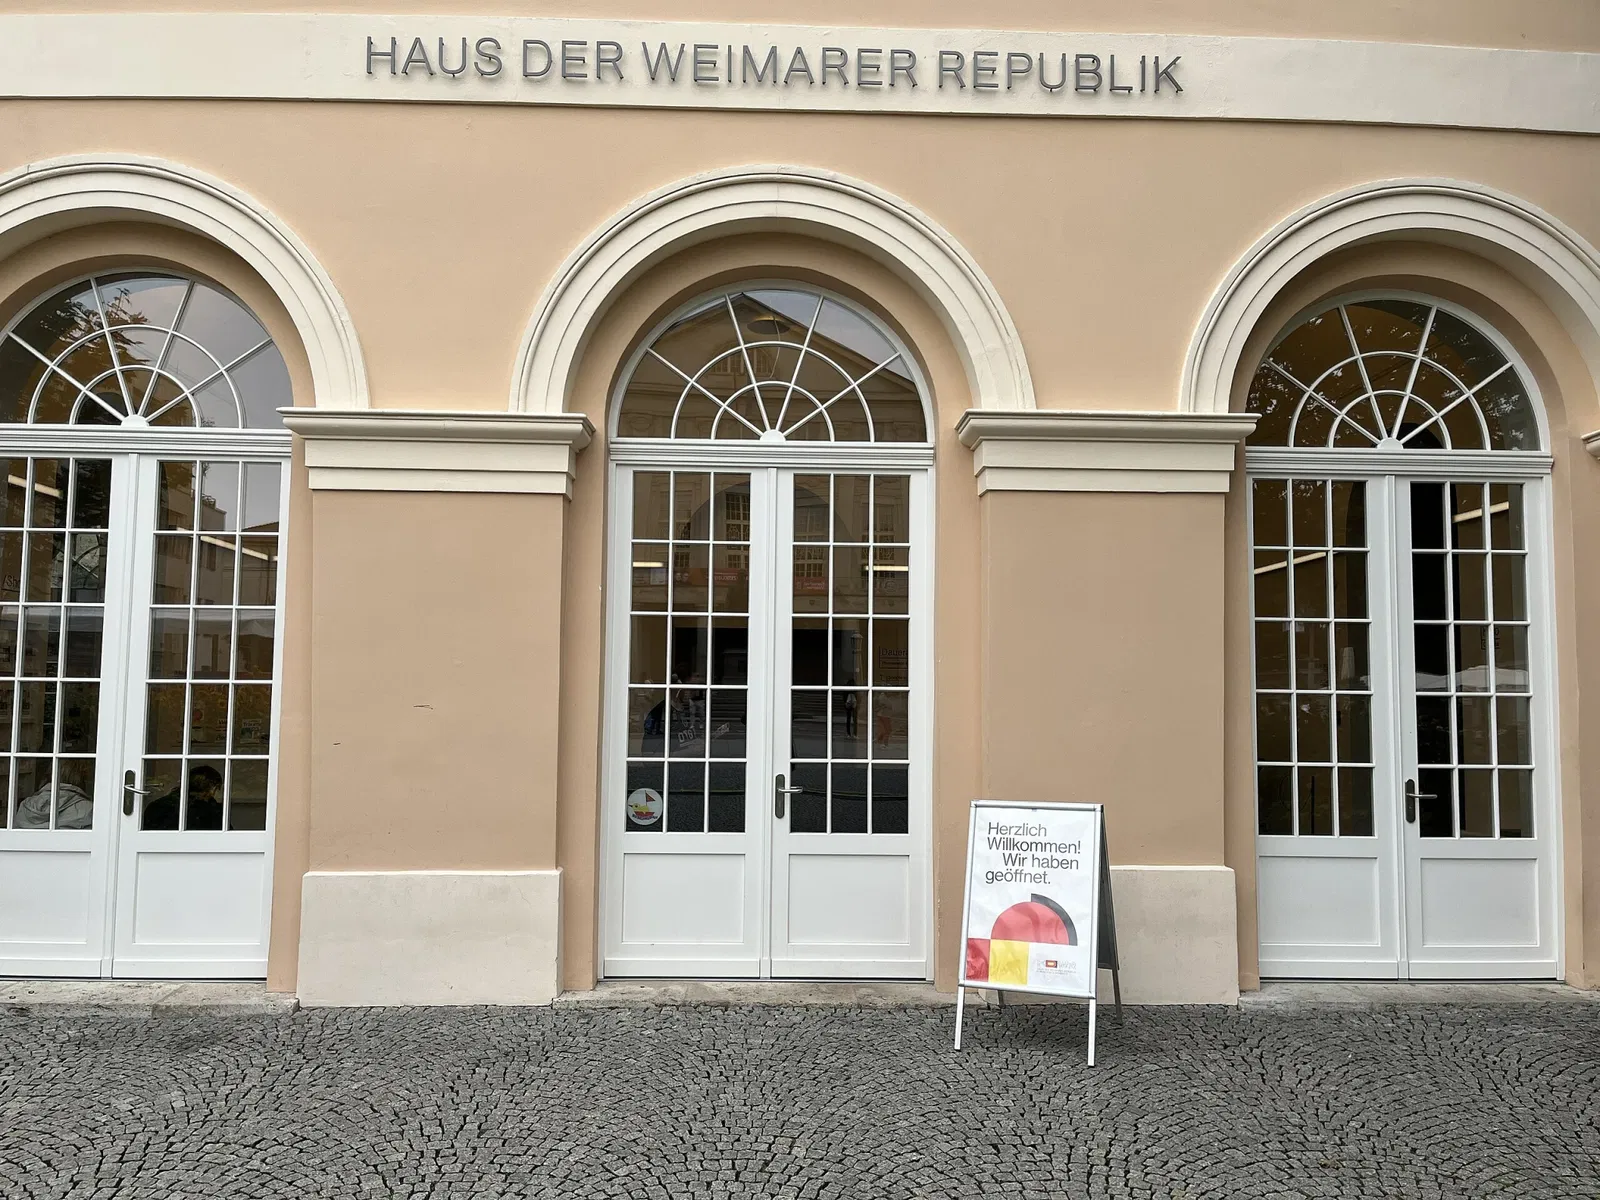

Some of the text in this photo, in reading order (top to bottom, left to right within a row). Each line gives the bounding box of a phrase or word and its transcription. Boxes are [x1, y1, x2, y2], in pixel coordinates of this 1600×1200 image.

[366, 36, 1184, 93] HAUS DER WEIMARER REPUBLIK
[987, 822, 1047, 837] Herzlich
[987, 837, 1081, 854] Willkommen!
[1003, 852, 1079, 870] Wir haben
[985, 869, 1051, 885] geöffnet.
